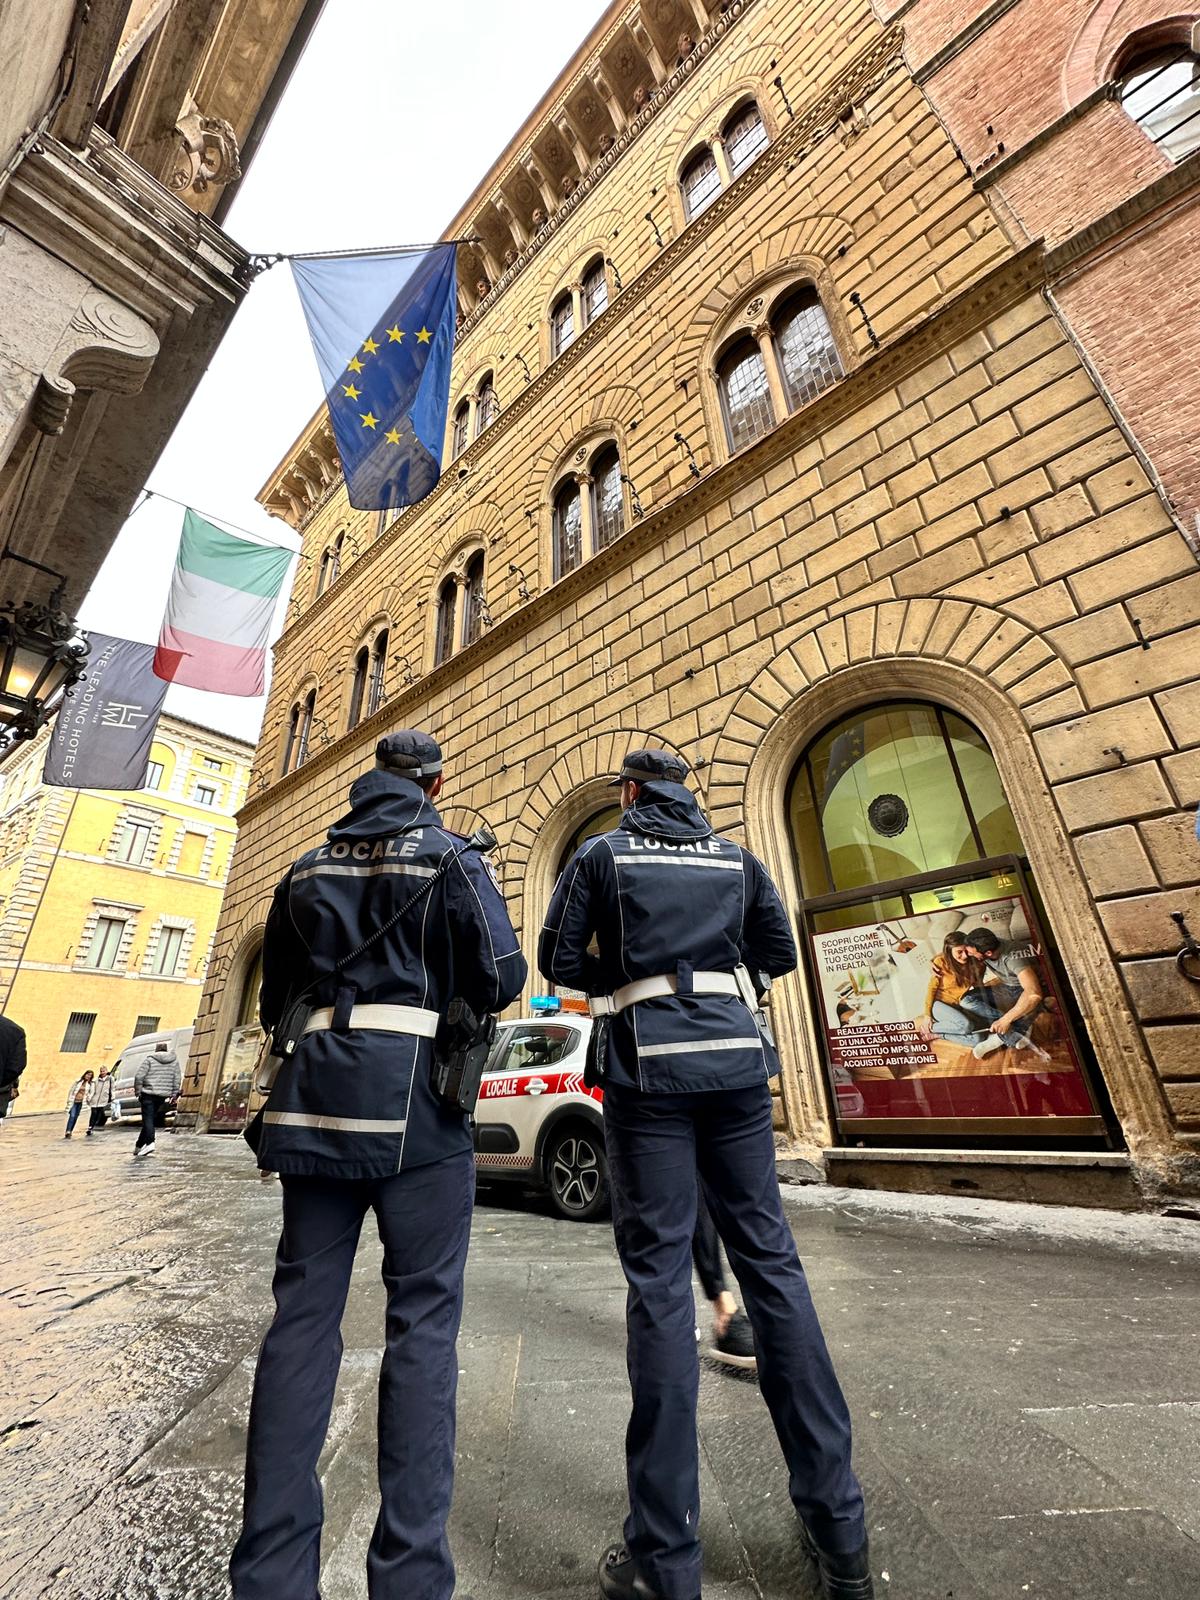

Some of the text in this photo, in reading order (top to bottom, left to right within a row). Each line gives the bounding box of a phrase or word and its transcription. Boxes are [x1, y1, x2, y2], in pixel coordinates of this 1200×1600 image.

[97, 645, 117, 668] THE
[75, 671, 103, 725] LEADING
[62, 728, 82, 778] HOTELS
[315, 840, 420, 861] LOCALE
[628, 836, 723, 854] LOCALE
[821, 932, 879, 949] SCOPRI COME
[823, 940, 884, 957] TRASFORMARE
[824, 950, 873, 965] TUO SOGNO
[826, 965, 834, 973] IN
[837, 1022, 914, 1036] REALIZZA IL SOGNO
[839, 1033, 919, 1047] DI UNA CASA NUOVA
[841, 1044, 928, 1057] CON MUTUO MPS MIO
[843, 1055, 936, 1068] ACQUISTO ABITAZIONE
[486, 1079, 518, 1097] LOCALE
